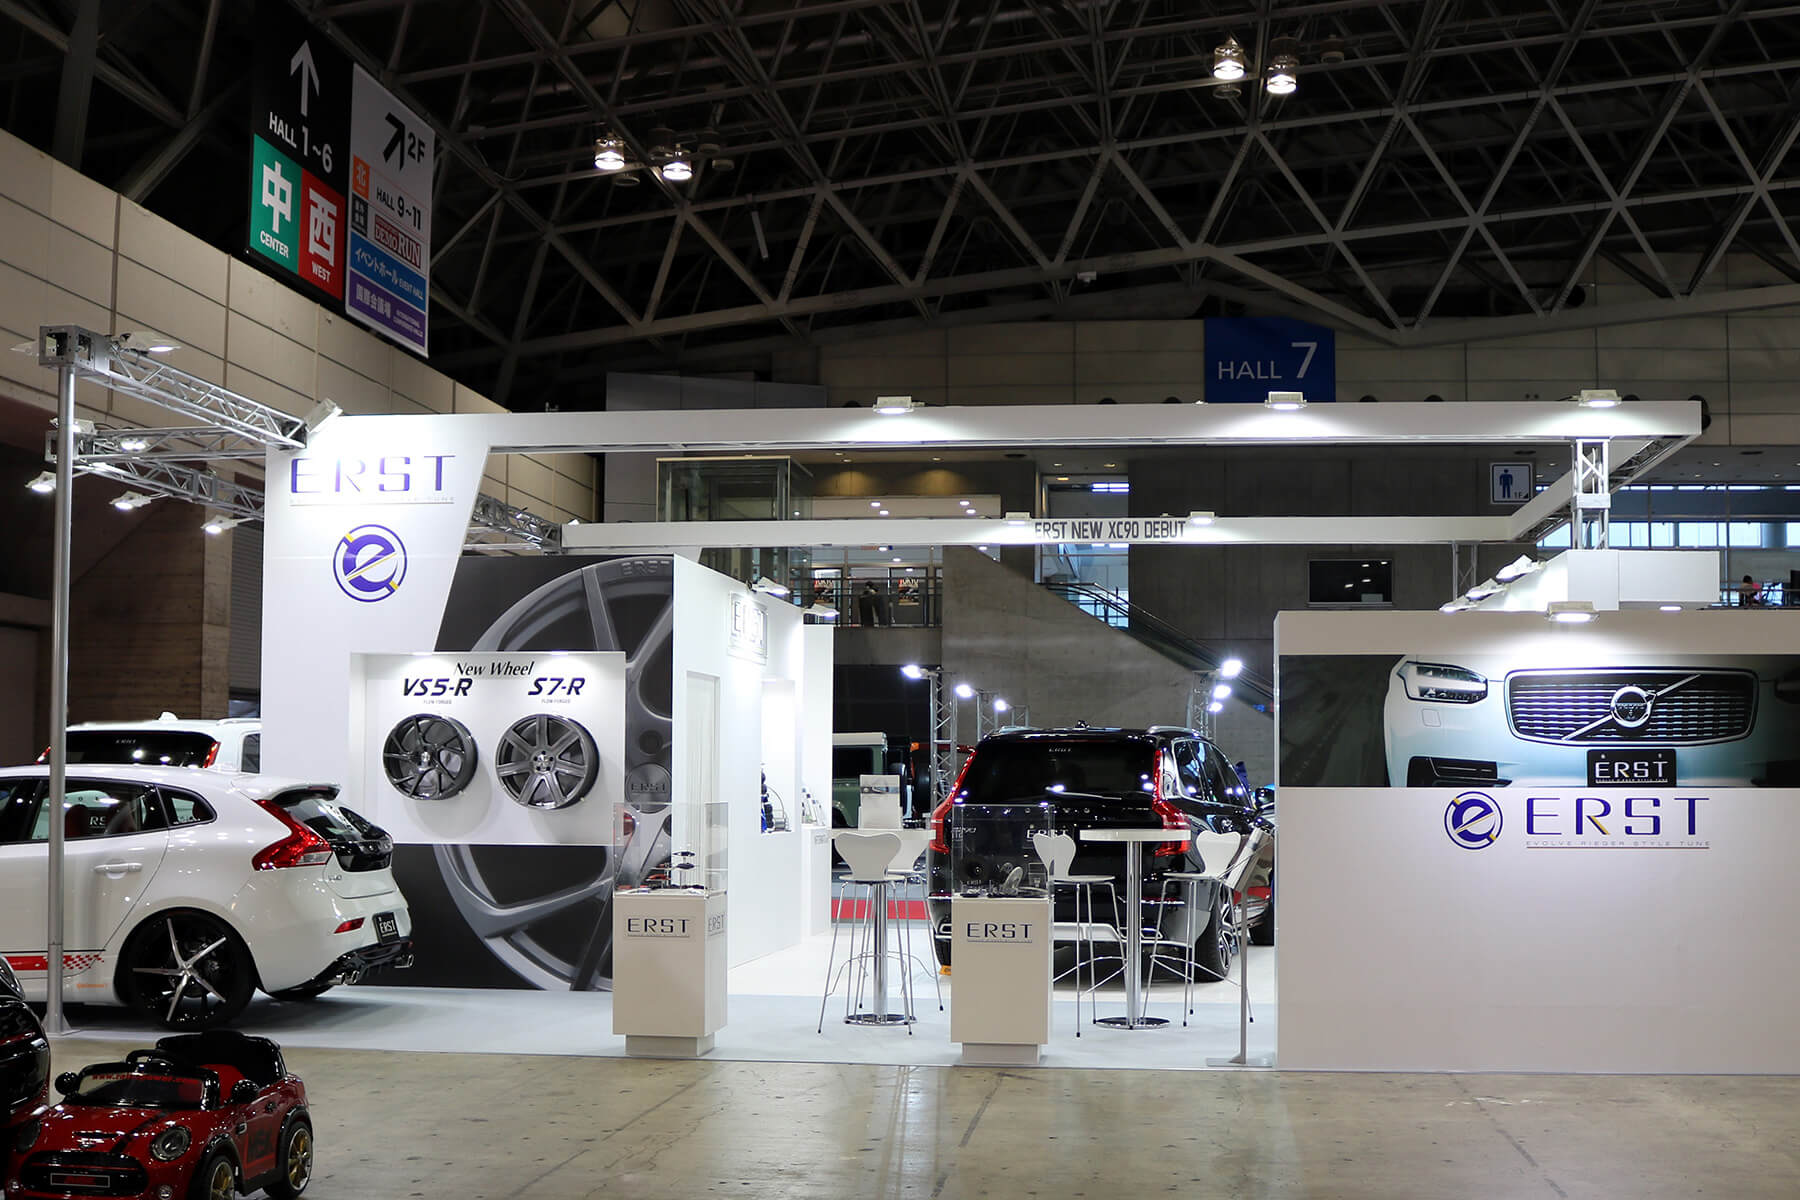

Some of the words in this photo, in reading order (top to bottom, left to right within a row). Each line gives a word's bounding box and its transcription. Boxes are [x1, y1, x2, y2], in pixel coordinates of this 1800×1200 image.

[268, 111, 297, 149] HALL
[301, 124, 333, 174] 1~6
[407, 131, 426, 164] 2F
[262, 160, 293, 234] 中
[376, 187, 395, 212] HALL
[397, 195, 422, 231] 9~11
[309, 187, 338, 267] 西
[260, 230, 290, 259] CENTER
[398, 232, 422, 268] RUN
[311, 260, 331, 283] WEST
[354, 247, 400, 286] イベントホール
[1218, 360, 1282, 380] HALL
[1291, 341, 1318, 379] 7
[290, 455, 456, 494] ERST
[1034, 521, 1068, 540] ERST
[1071, 521, 1103, 539] NEW
[1108, 521, 1140, 539] XC90
[1144, 521, 1186, 539] DEBUT
[454, 661, 485, 676] New
[489, 660, 535, 676] Wheel
[403, 677, 473, 697] VS5-R
[527, 677, 586, 696] S7-R
[1595, 760, 1669, 778] ERST
[1526, 797, 1710, 836] ERST
[627, 918, 690, 933] ERST
[708, 913, 725, 933] ERST
[966, 922, 1033, 939] ERST
